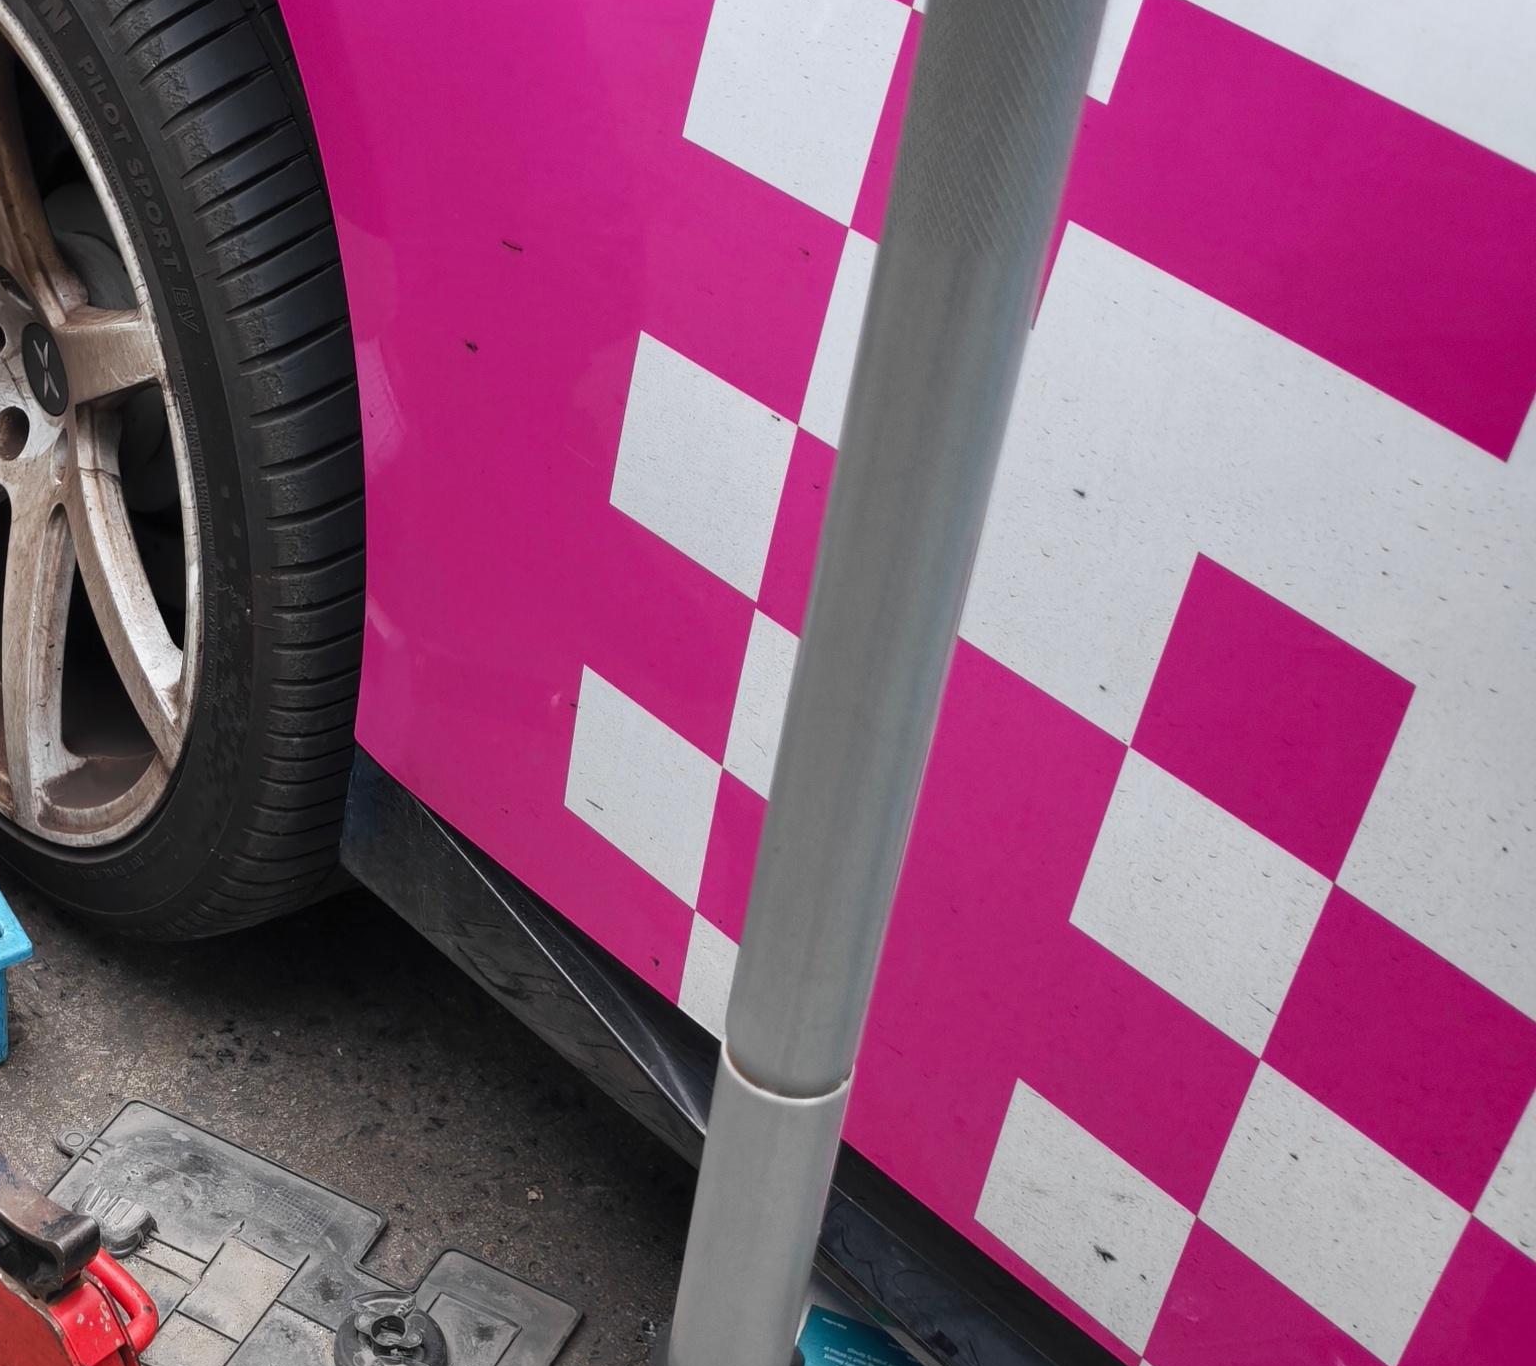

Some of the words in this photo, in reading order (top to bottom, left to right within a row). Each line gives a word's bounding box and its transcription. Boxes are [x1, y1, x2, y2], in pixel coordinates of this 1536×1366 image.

[78, 55, 133, 145] PILOT
[126, 156, 183, 274] SPORT
[171, 288, 201, 334] EV
